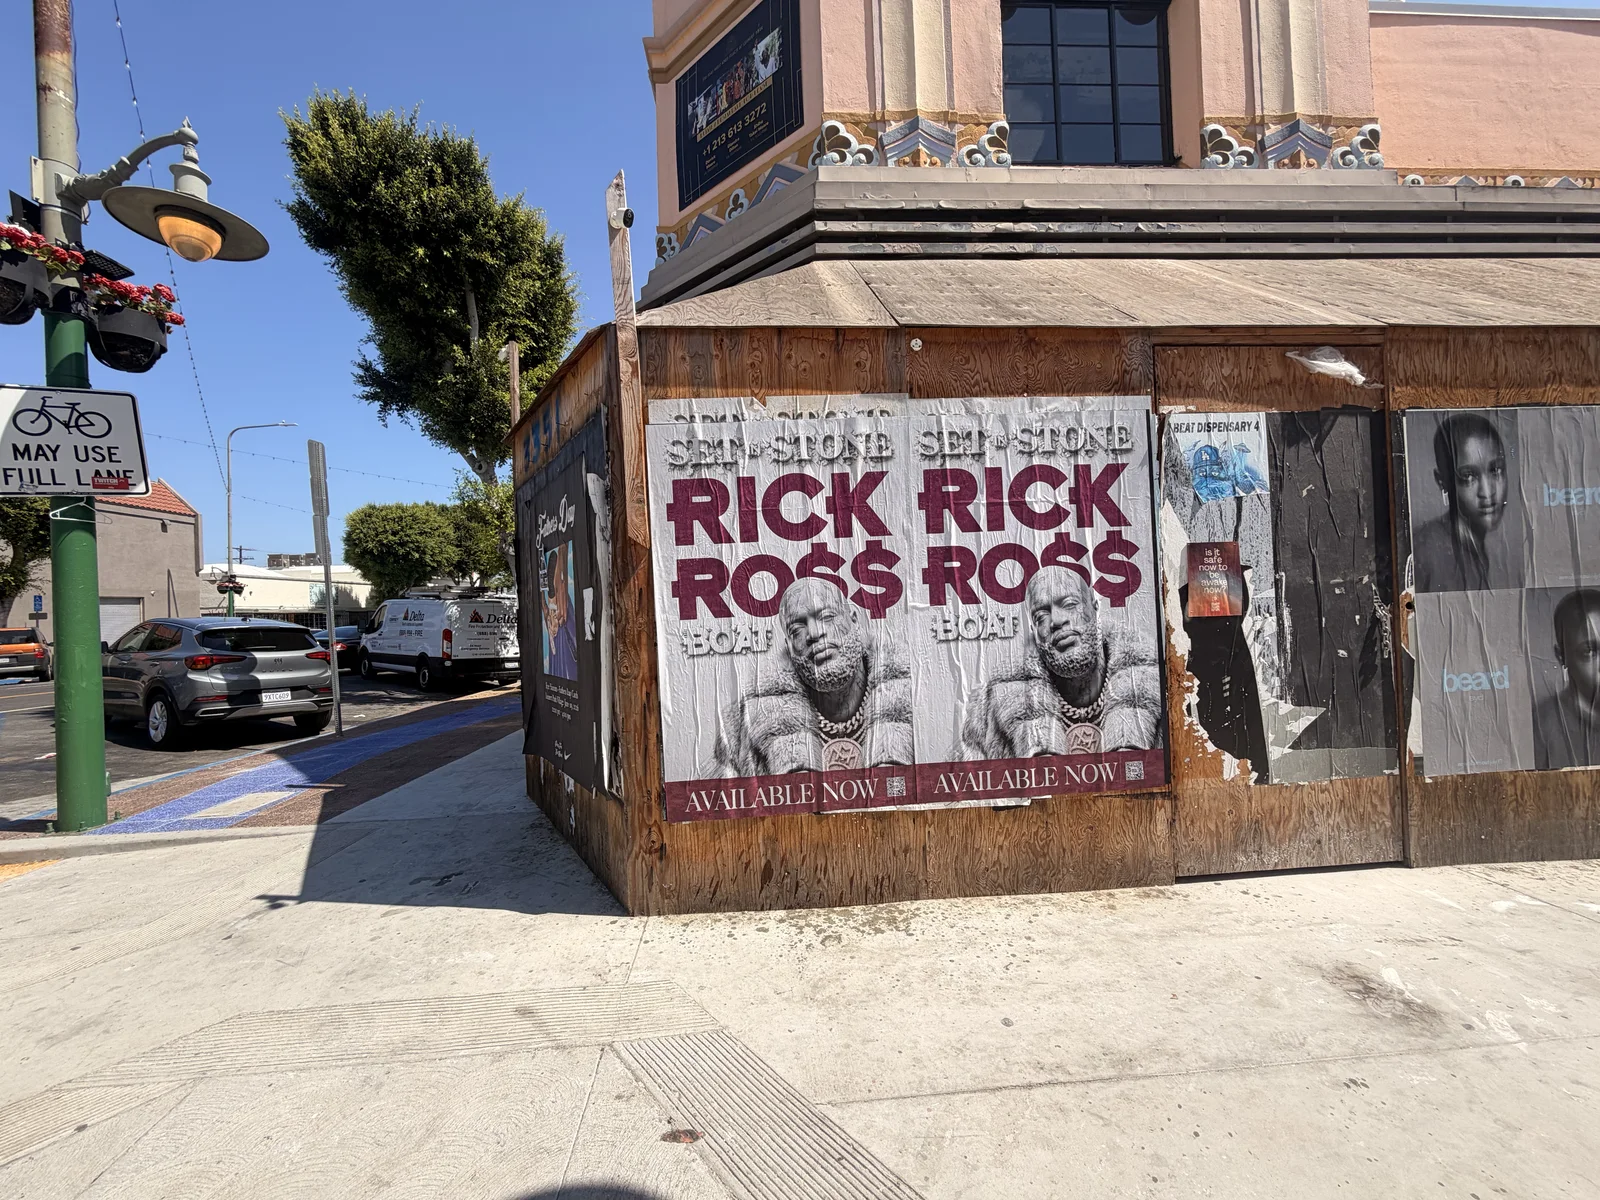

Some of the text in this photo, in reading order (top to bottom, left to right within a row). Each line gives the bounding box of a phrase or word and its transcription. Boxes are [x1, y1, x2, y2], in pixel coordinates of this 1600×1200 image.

[712, 135, 727, 151] 213
[727, 124, 743, 139] 613
[744, 102, 767, 127] 3272
[1173, 420, 1259, 433] BEAT DISPENSARY 4
[11, 443, 122, 463] MAY USE
[772, 432, 893, 463] STONE
[919, 428, 986, 457] SET
[1016, 425, 1133, 455] STONE
[2, 467, 66, 486] FULL
[666, 470, 893, 546] RICK
[918, 463, 1132, 534] RICK
[558, 494, 576, 533] Day
[1203, 555, 1223, 564] safe
[1205, 548, 1220, 556] is it
[1201, 578, 1228, 586] awake
[1209, 570, 1220, 579] be
[1203, 585, 1227, 594] now?
[408, 610, 425, 621] Delta
[486, 613, 518, 624] Delta
[934, 613, 1017, 641] BOAT
[1442, 664, 1510, 693] beard
[934, 762, 1118, 794] AVAILABLE NOW
[685, 778, 879, 813] AVAILABLE NOW
